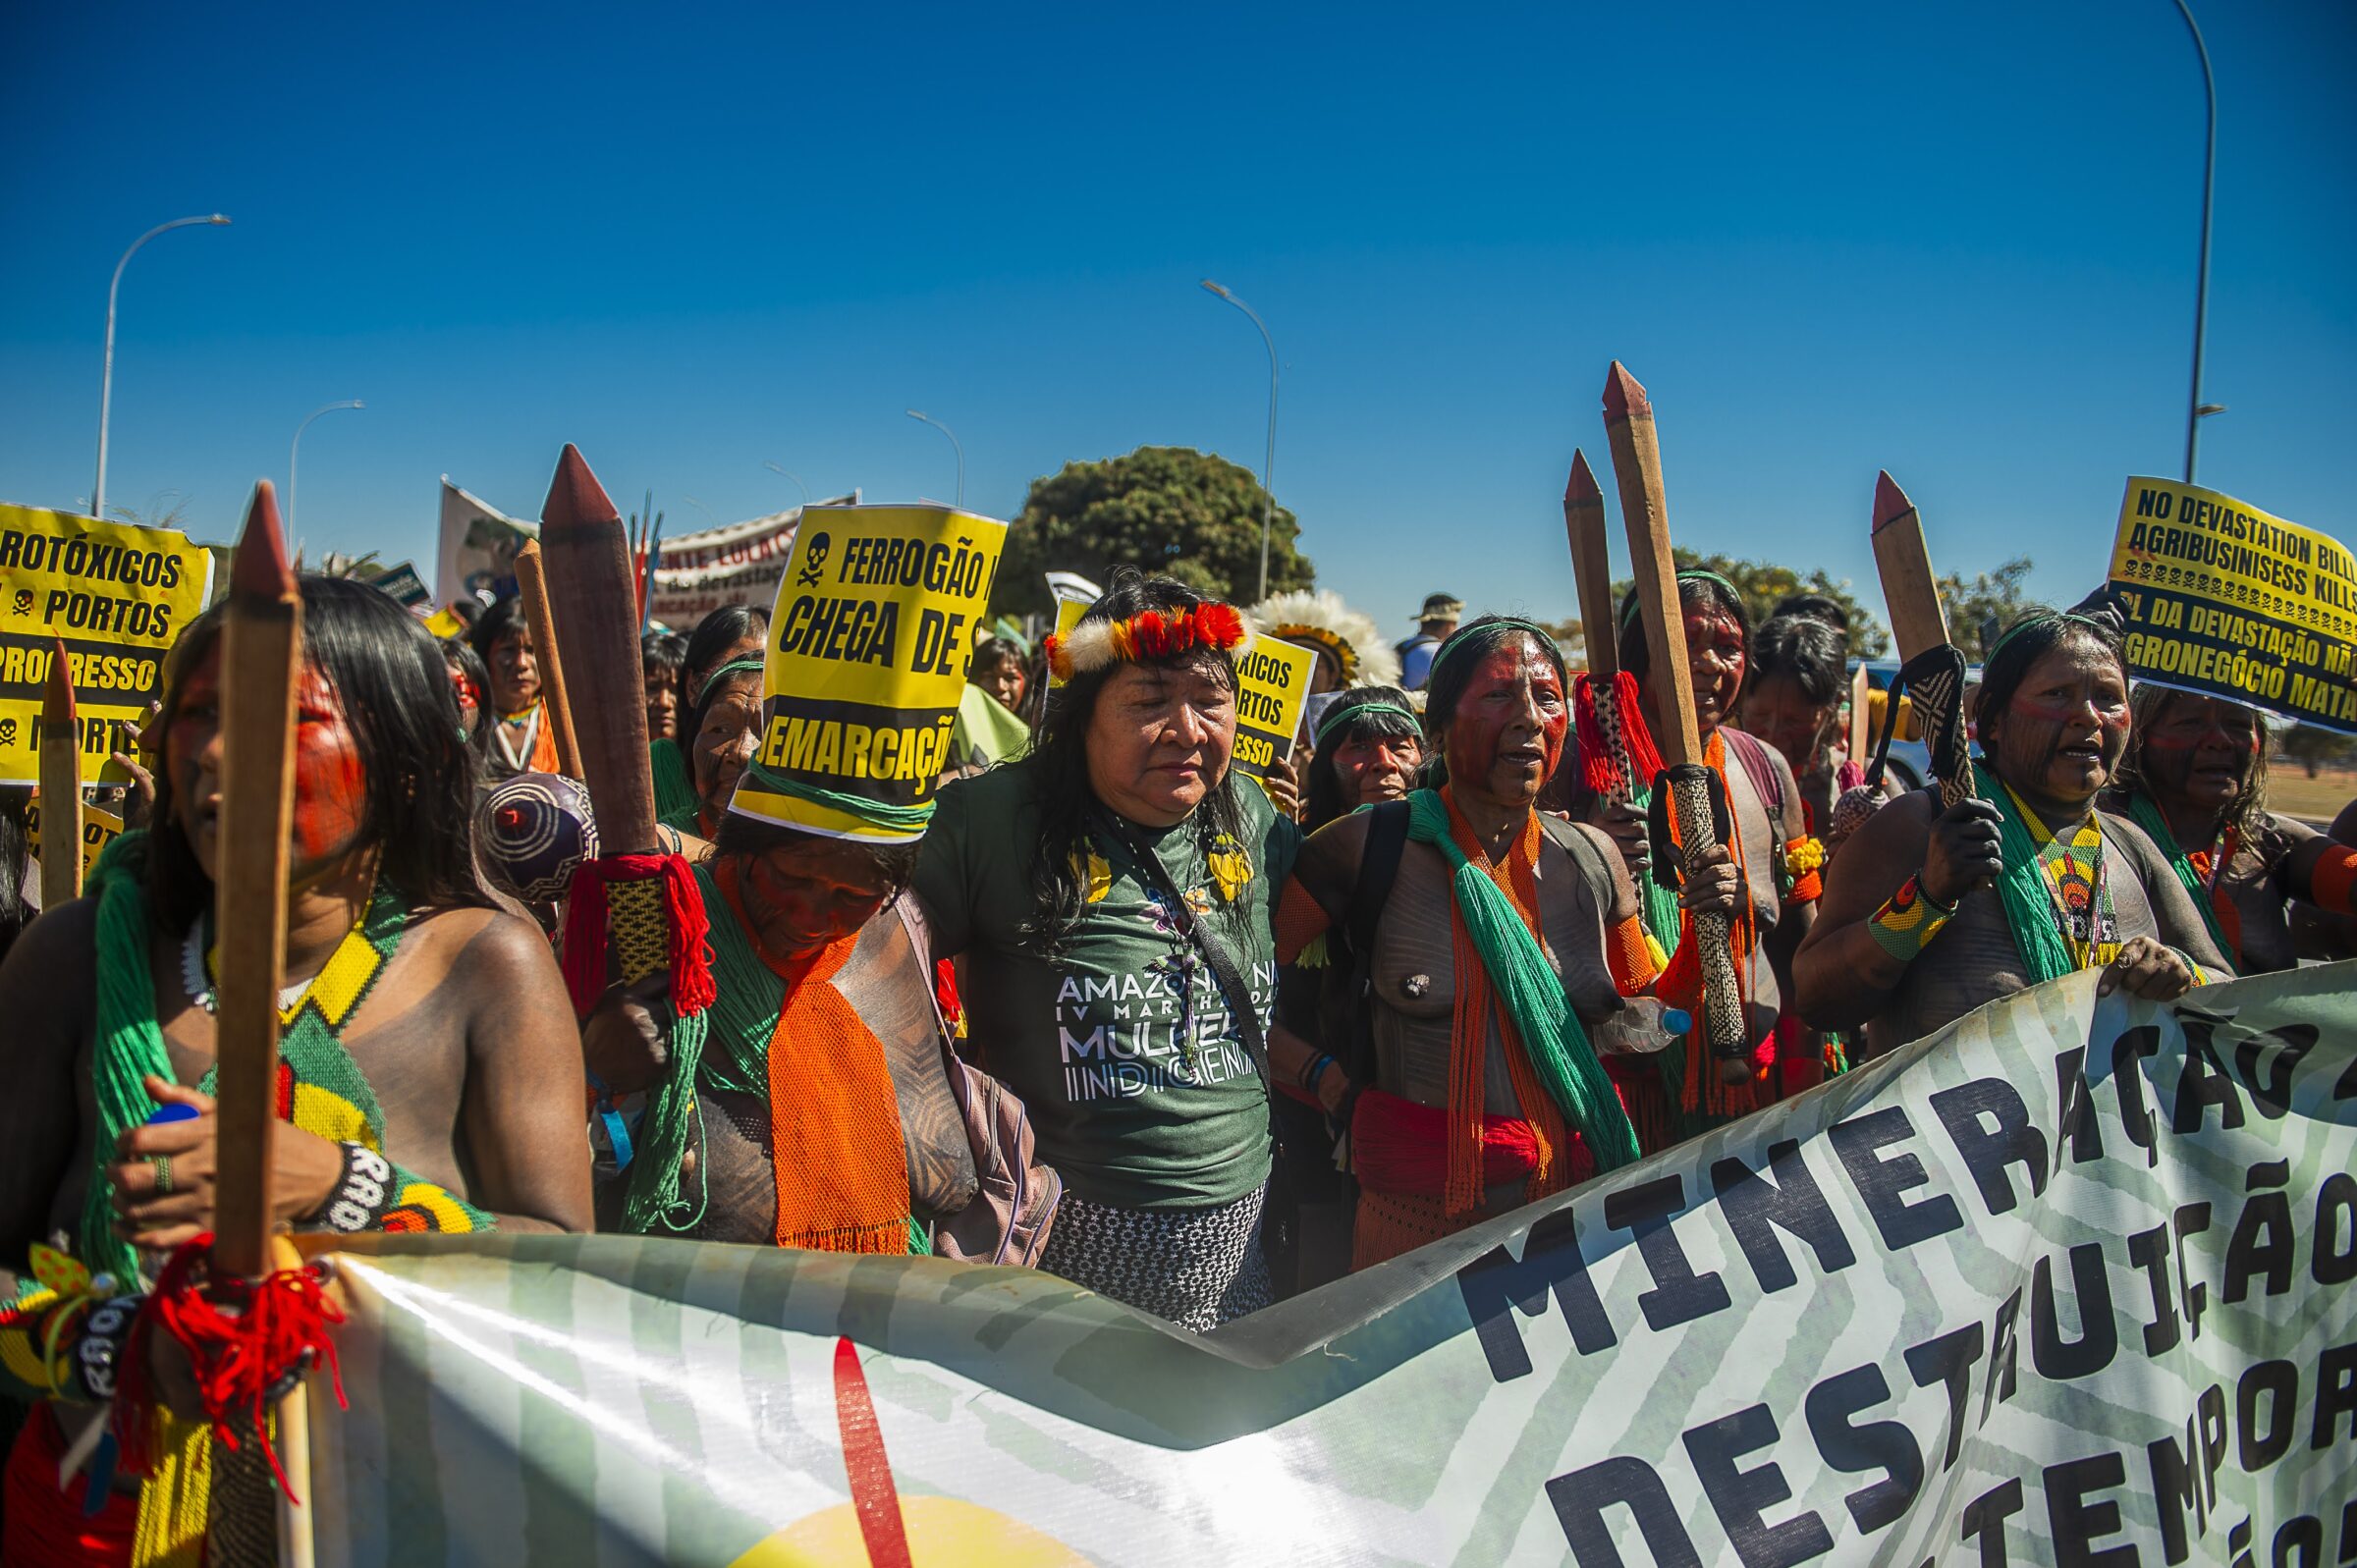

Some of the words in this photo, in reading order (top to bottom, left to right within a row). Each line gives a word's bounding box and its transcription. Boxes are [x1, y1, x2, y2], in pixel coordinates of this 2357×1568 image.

[2128, 522, 2308, 596] AGRIBUSINISESS
[2136, 489, 2172, 519] NO
[2178, 496, 2311, 565] DEVASTATION
[838, 536, 984, 599] FERROGÃO
[43, 589, 172, 639] PORTOS
[779, 595, 900, 668] CHEGA
[910, 608, 965, 676] DE
[2150, 598, 2183, 628] DA
[2189, 606, 2320, 667] DEVASTAÇÃO
[2121, 632, 2285, 699] GRONEGÓCIO
[2288, 673, 2357, 723] MATA
[1056, 1005, 1089, 1022] IV
[1457, 1005, 2320, 1384] MINERAÇÃO
